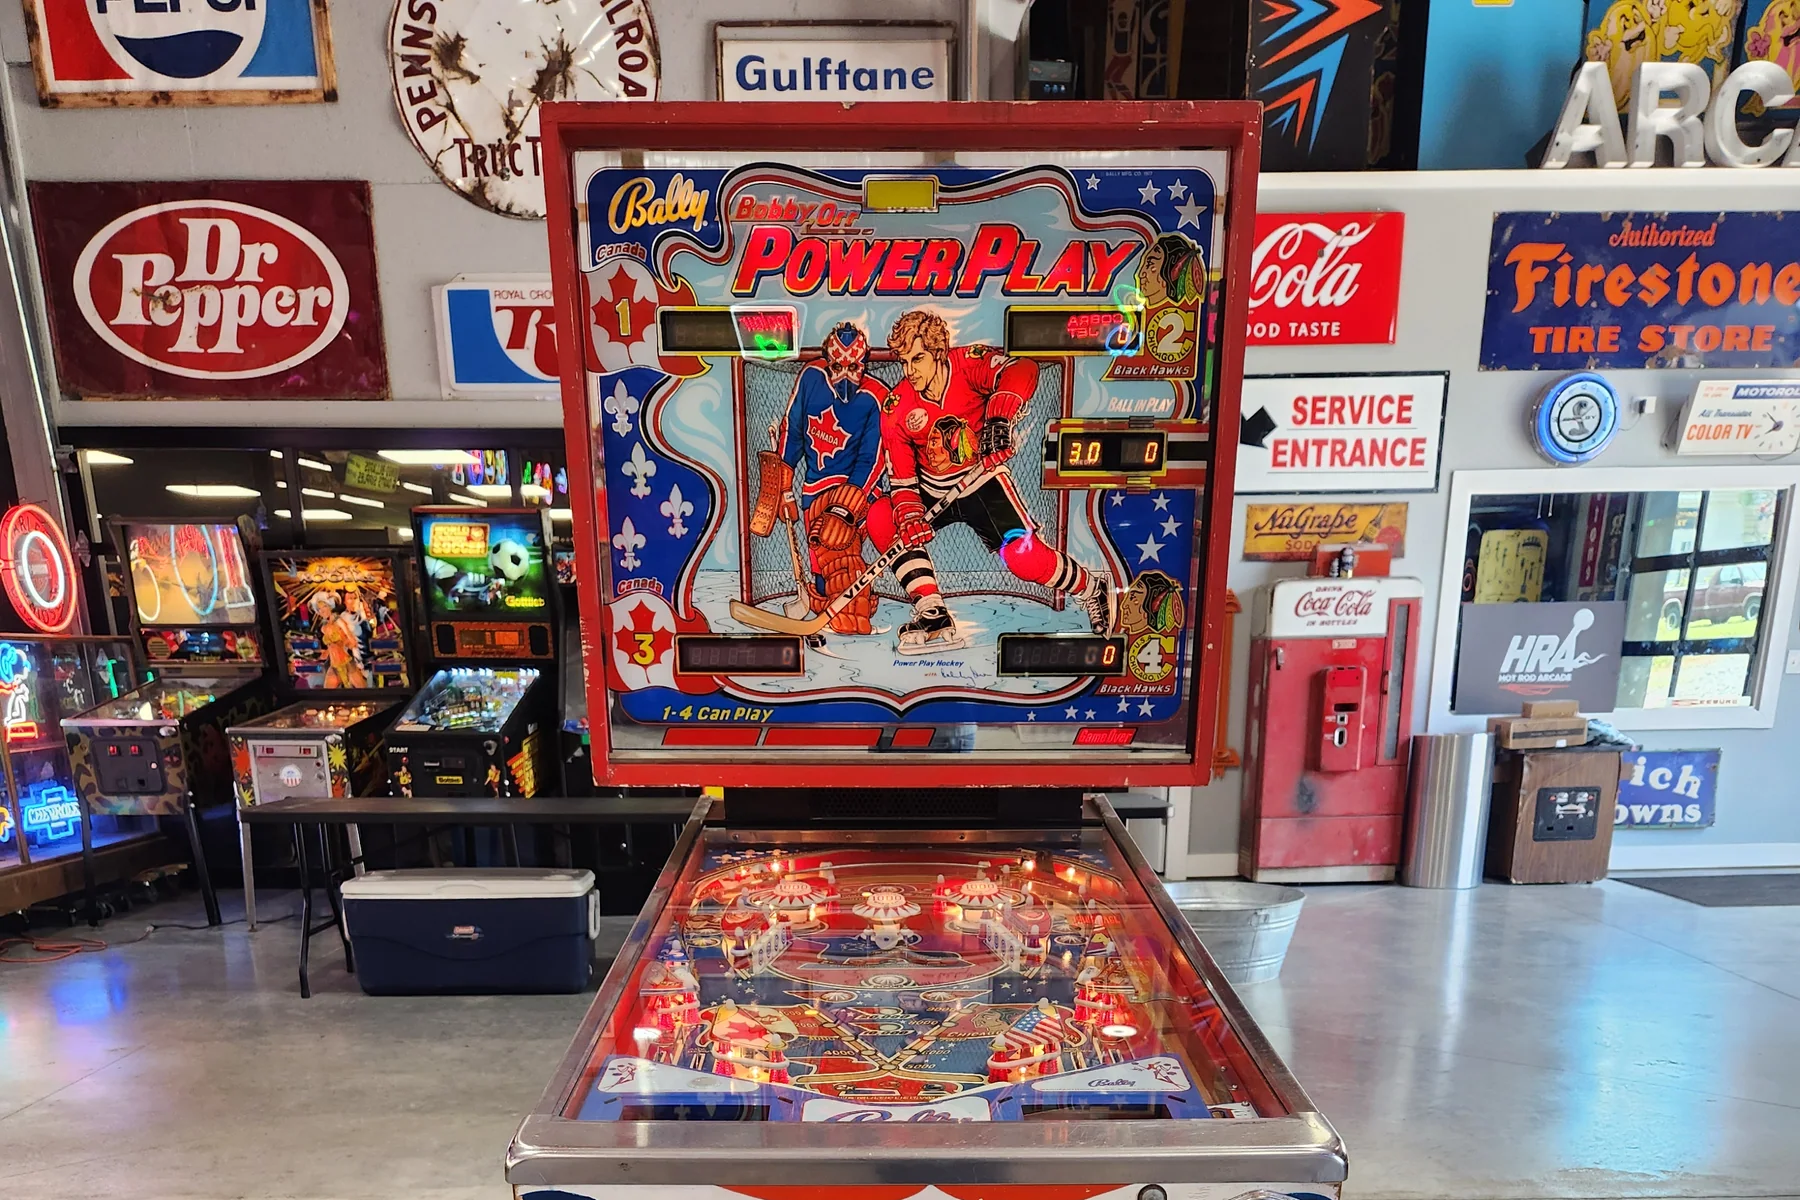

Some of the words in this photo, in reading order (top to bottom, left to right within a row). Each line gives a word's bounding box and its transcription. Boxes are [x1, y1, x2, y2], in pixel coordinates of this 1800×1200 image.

[599, 0, 649, 97] LROA
[735, 54, 935, 92] Gulftane
[1541, 60, 1800, 168] ARC
[608, 172, 710, 235] Bally
[735, 195, 814, 224] Bobby
[817, 201, 862, 228] Orr
[1609, 222, 1717, 247] Authorized
[174, 218, 279, 282] Dr
[594, 241, 648, 263] Canada
[731, 224, 967, 297] POWER
[956, 223, 1148, 298] PLAY
[1504, 243, 1800, 313] Firestone
[109, 253, 332, 354] Pepper
[494, 289, 526, 300] ROYAL
[529, 289, 553, 300] CRO
[615, 298, 632, 336] 1
[1246, 322, 1280, 338] OD
[1289, 321, 1341, 338] TASTE
[1529, 326, 1621, 353] TIRE
[1637, 325, 1776, 352] STORE
[1113, 365, 1147, 376] Black
[1149, 365, 1190, 376] Hawks
[1108, 397, 1133, 412] BALL
[1133, 399, 1147, 412] IN
[1146, 397, 1175, 412] PLAY
[1291, 394, 1414, 426] SERVICE
[811, 426, 839, 447] CANADA
[1686, 424, 1732, 440] COLOR
[1735, 424, 1753, 440] TV
[1271, 436, 1427, 468] ENTRANCE
[1254, 506, 1358, 538] NuGrape
[617, 576, 665, 596] Canada
[632, 633, 655, 665] 3
[918, 660, 934, 668] Play
[936, 660, 964, 668] Hockey
[1499, 626, 1581, 673] HRA
[1100, 684, 1131, 693] Black
[1132, 684, 1171, 693] Hawks
[1498, 673, 1518, 683] HOT
[1518, 673, 1537, 682] ROD
[1536, 673, 1573, 682] ARCADE
[697, 707, 730, 721] Can
[735, 706, 774, 724] Play
[1088, 1079, 1136, 1087] Bally
